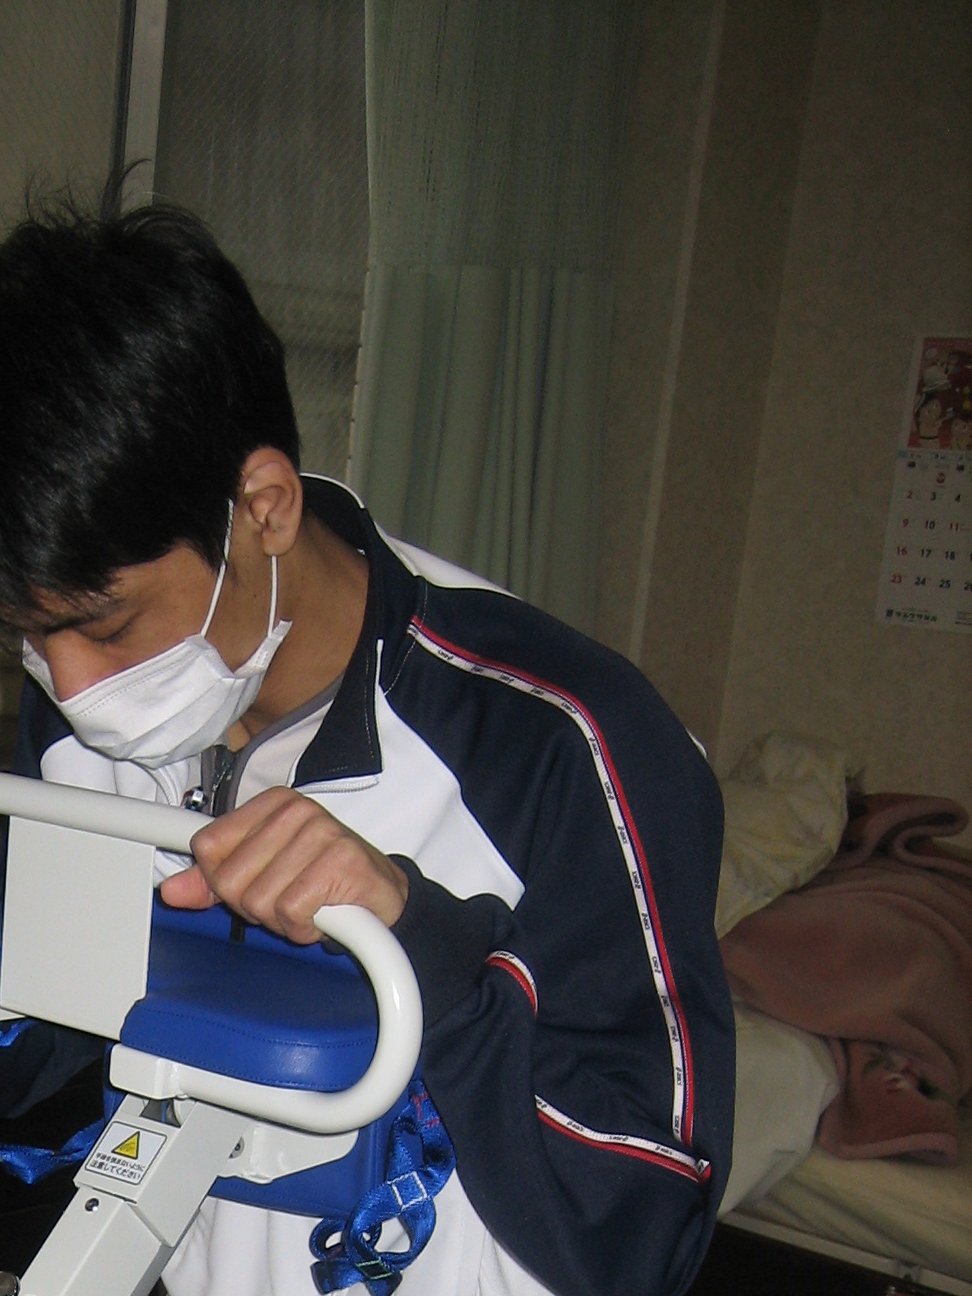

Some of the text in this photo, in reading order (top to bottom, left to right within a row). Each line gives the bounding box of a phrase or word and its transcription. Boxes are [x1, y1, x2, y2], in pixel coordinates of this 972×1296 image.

[907, 490, 961, 502] 2 3 4
[903, 518, 959, 532] 9 10 11
[896, 546, 956, 561] 16 17 18
[891, 575, 903, 584] 23
[915, 576, 927, 586] 24
[939, 579, 951, 589] 25
